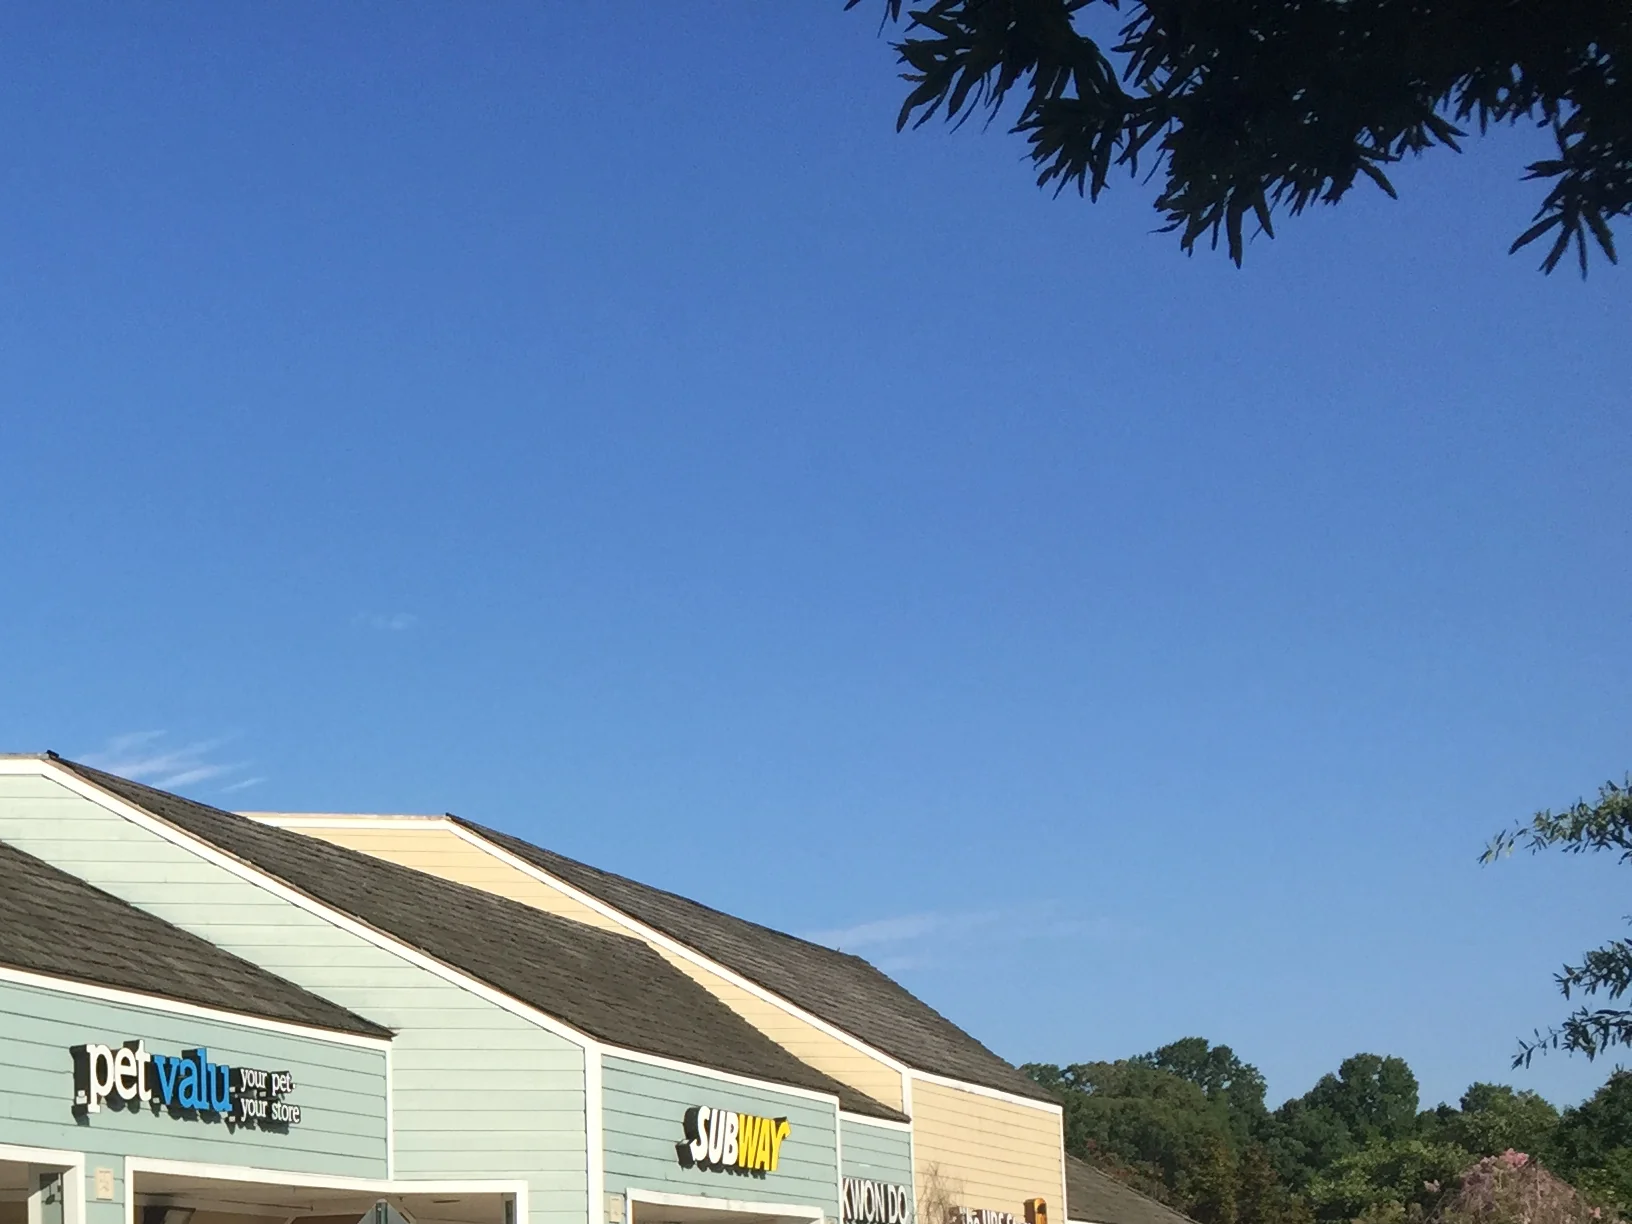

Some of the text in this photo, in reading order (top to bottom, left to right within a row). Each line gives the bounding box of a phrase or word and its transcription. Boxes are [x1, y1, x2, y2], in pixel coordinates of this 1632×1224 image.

[86, 1039, 233, 1113] pet valu
[240, 1067, 268, 1092] your
[240, 1098, 301, 1123] your store
[689, 1105, 792, 1172] SUBWAY
[843, 1177, 885, 1223] KWON
